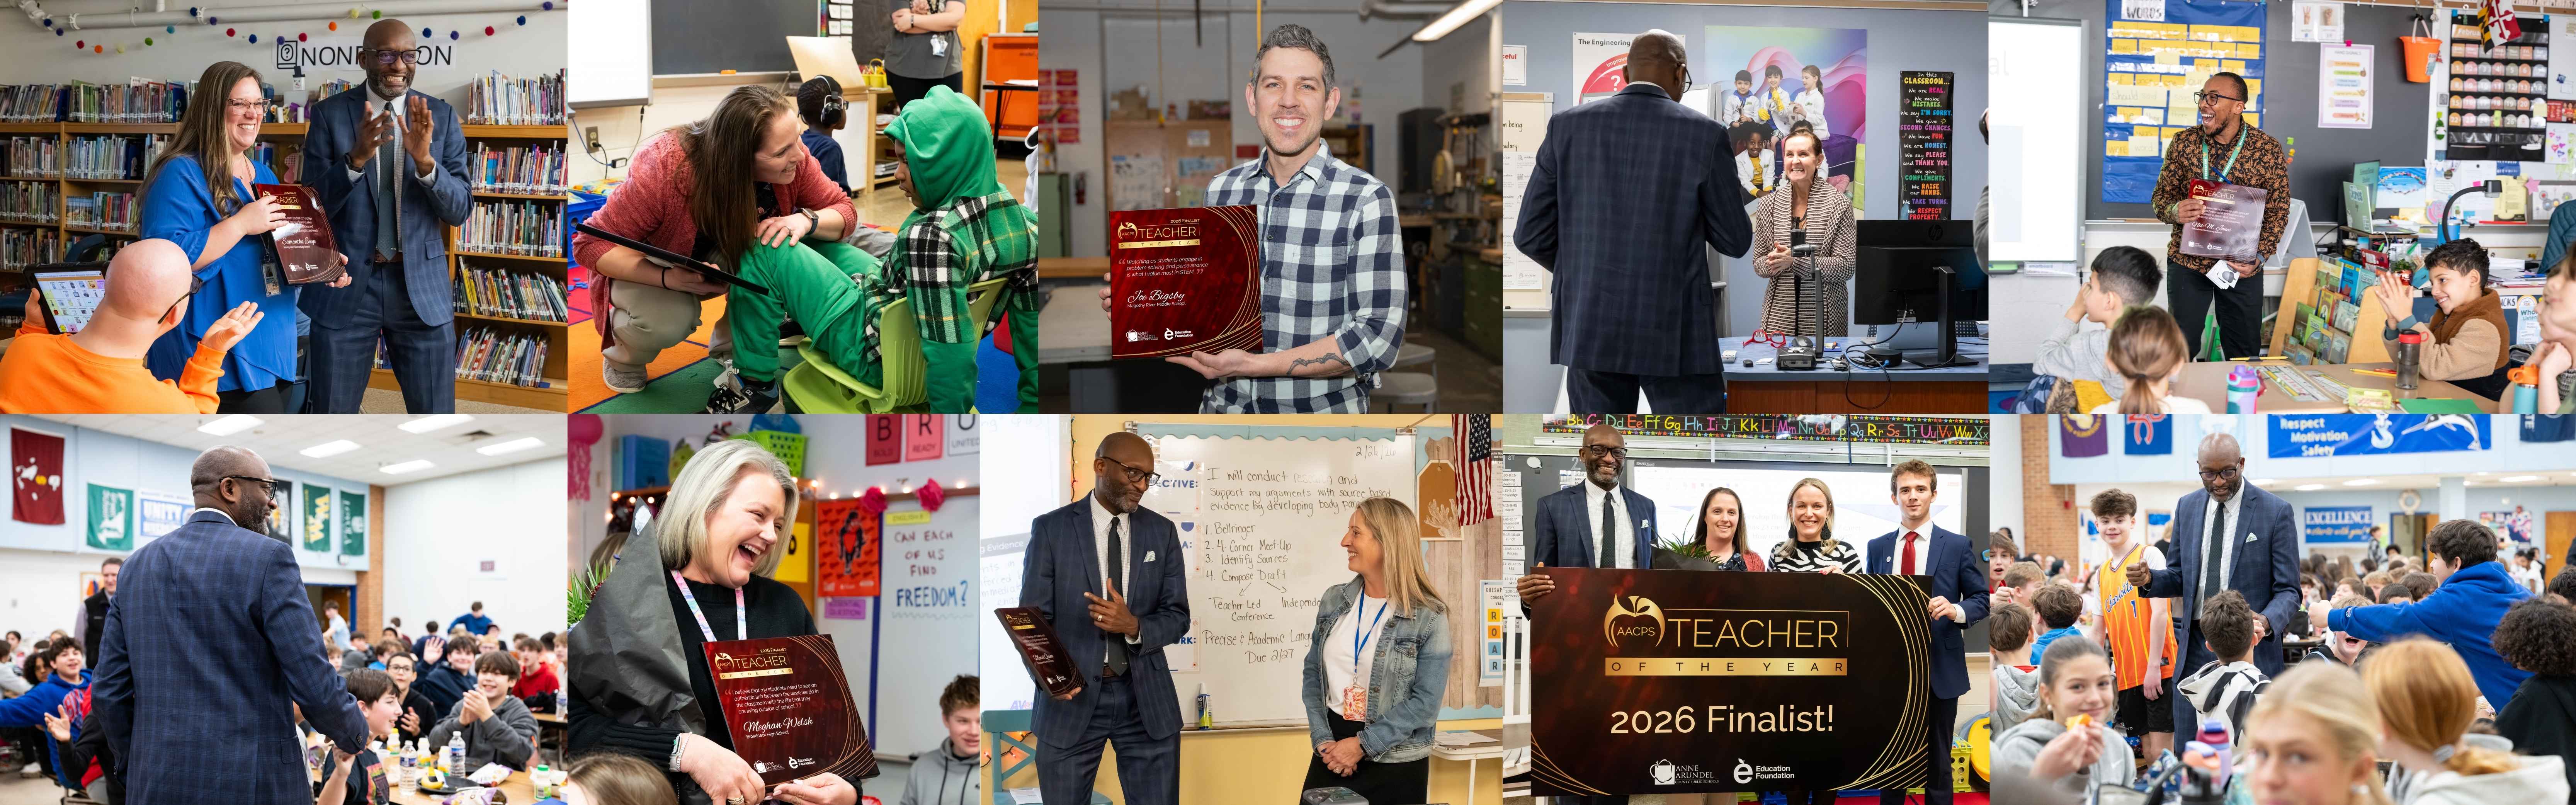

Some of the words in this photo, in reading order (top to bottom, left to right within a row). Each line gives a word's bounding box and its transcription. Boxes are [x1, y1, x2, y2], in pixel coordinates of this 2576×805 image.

[2127, 7, 2162, 19] WORDS
[2112, 90, 2138, 100] should
[1509, 121, 1522, 132] being
[2134, 143, 2153, 152] word
[2204, 189, 2234, 200] TEACHER
[1138, 226, 1196, 238] TEACHER
[1127, 290, 1147, 303] Joe
[1149, 290, 1185, 302] Bigsby
[877, 416, 892, 441] B
[2280, 417, 2325, 431] Respect
[2290, 431, 2348, 443] Motivation
[2301, 444, 2336, 457] Safety
[1207, 468, 1221, 481] I
[1227, 469, 1243, 482] will
[1247, 470, 1289, 482] conduct
[1338, 473, 1358, 485] and
[1249, 488, 1261, 503] my
[1265, 489, 1311, 504] arguments
[1318, 488, 1335, 497] with
[1339, 489, 1365, 498] source
[1369, 487, 1391, 499] based
[2306, 510, 2372, 524] EXCELLENCE
[894, 531, 915, 543] CAN
[923, 531, 953, 541] EACH
[1205, 524, 1212, 535] 1.
[1214, 522, 1256, 540] Bellringer
[2335, 528, 2348, 536] with
[987, 541, 1024, 551] Evidence
[905, 550, 920, 560] OF
[928, 550, 944, 560] US
[1205, 554, 1213, 563] 3.
[1221, 554, 1253, 569] Identify
[1257, 555, 1288, 563] Sources
[910, 565, 936, 577] FIND
[1206, 570, 1215, 582] 4.
[1222, 569, 1253, 584] Compose
[1257, 568, 1286, 581] Draft
[896, 580, 968, 607] FREEDOM?
[2105, 580, 2133, 613] Charlotte
[1209, 597, 1244, 609] Teacher
[1247, 599, 1261, 609] Led
[2130, 599, 2137, 619] 1
[1231, 611, 1275, 622] Conference
[1202, 630, 1237, 645] Precise
[1248, 631, 1284, 646] Academic
[1617, 626, 1655, 637] AACPS
[1668, 619, 1838, 648] TEACHER
[733, 655, 787, 669] TEACHER
[1245, 650, 1267, 664] Due
[1271, 648, 1294, 663] 2/27
[1612, 662, 1646, 672] OF
[1675, 662, 1734, 672] THE
[1763, 662, 1843, 672] YEAR
[743, 721, 782, 733] Meghan
[783, 717, 813, 729] Welsh
[1611, 706, 1695, 734] 2026
[1708, 704, 1833, 733] Finalist!
